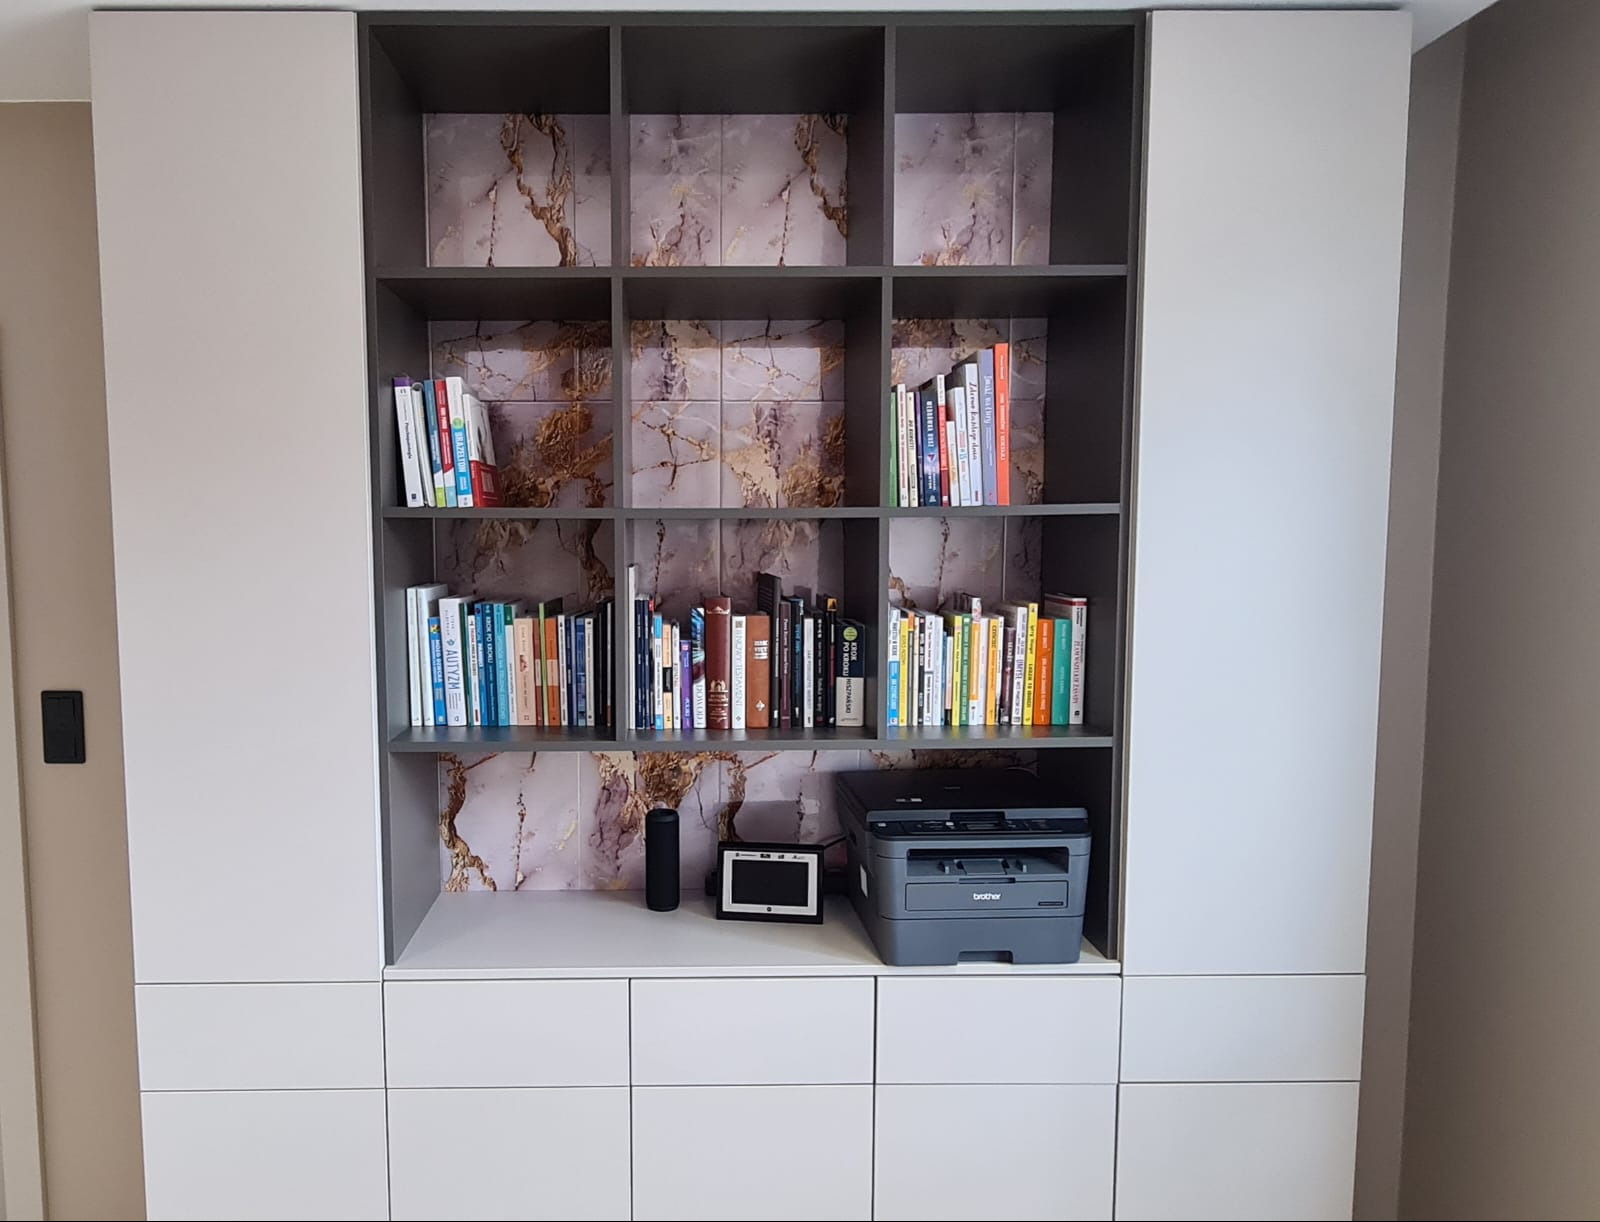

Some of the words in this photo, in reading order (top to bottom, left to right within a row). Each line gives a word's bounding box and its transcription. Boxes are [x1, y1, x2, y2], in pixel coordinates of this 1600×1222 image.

[487, 633, 493, 642] PO
[843, 641, 850, 652] PO
[850, 641, 858, 662] KROK
[446, 649, 460, 690] AUTYZM
[842, 652, 850, 677] KROKU
[735, 663, 743, 707] TESTAMENT
[973, 892, 1001, 900] brother
